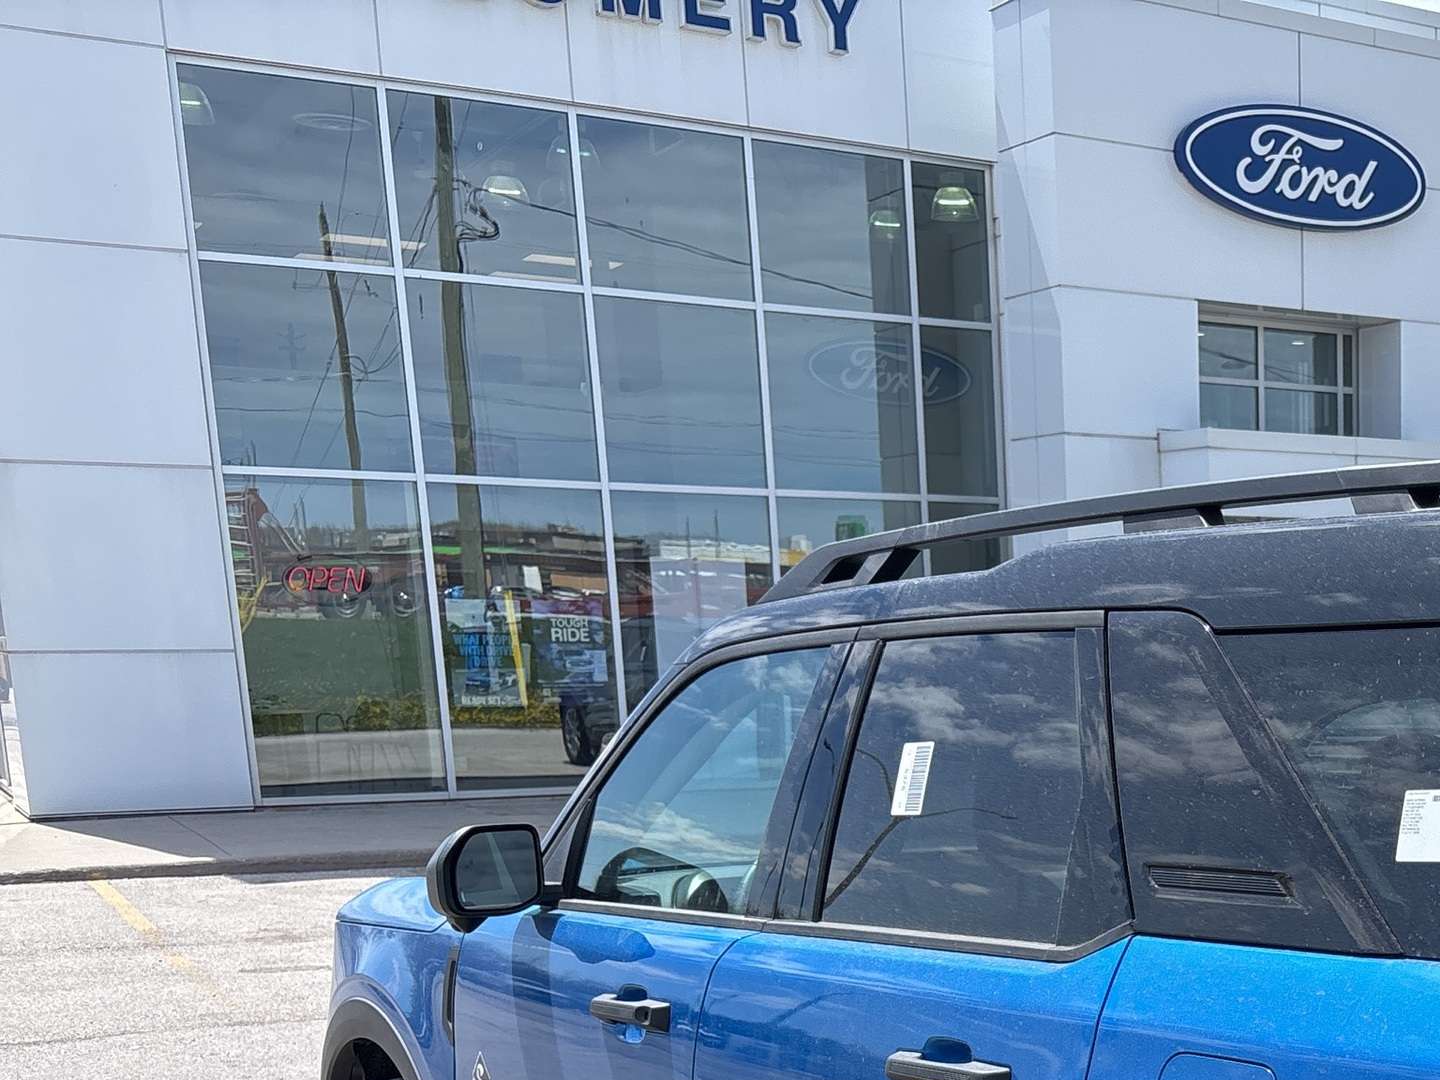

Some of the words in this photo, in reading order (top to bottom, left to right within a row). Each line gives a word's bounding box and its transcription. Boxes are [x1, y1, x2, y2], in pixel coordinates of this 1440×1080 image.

[1235, 124, 1379, 210] Ford
[840, 347, 942, 397] Ford
[288, 566, 366, 592] OPEN
[550, 617, 588, 628] TOUGH
[551, 628, 591, 642] RIDE
